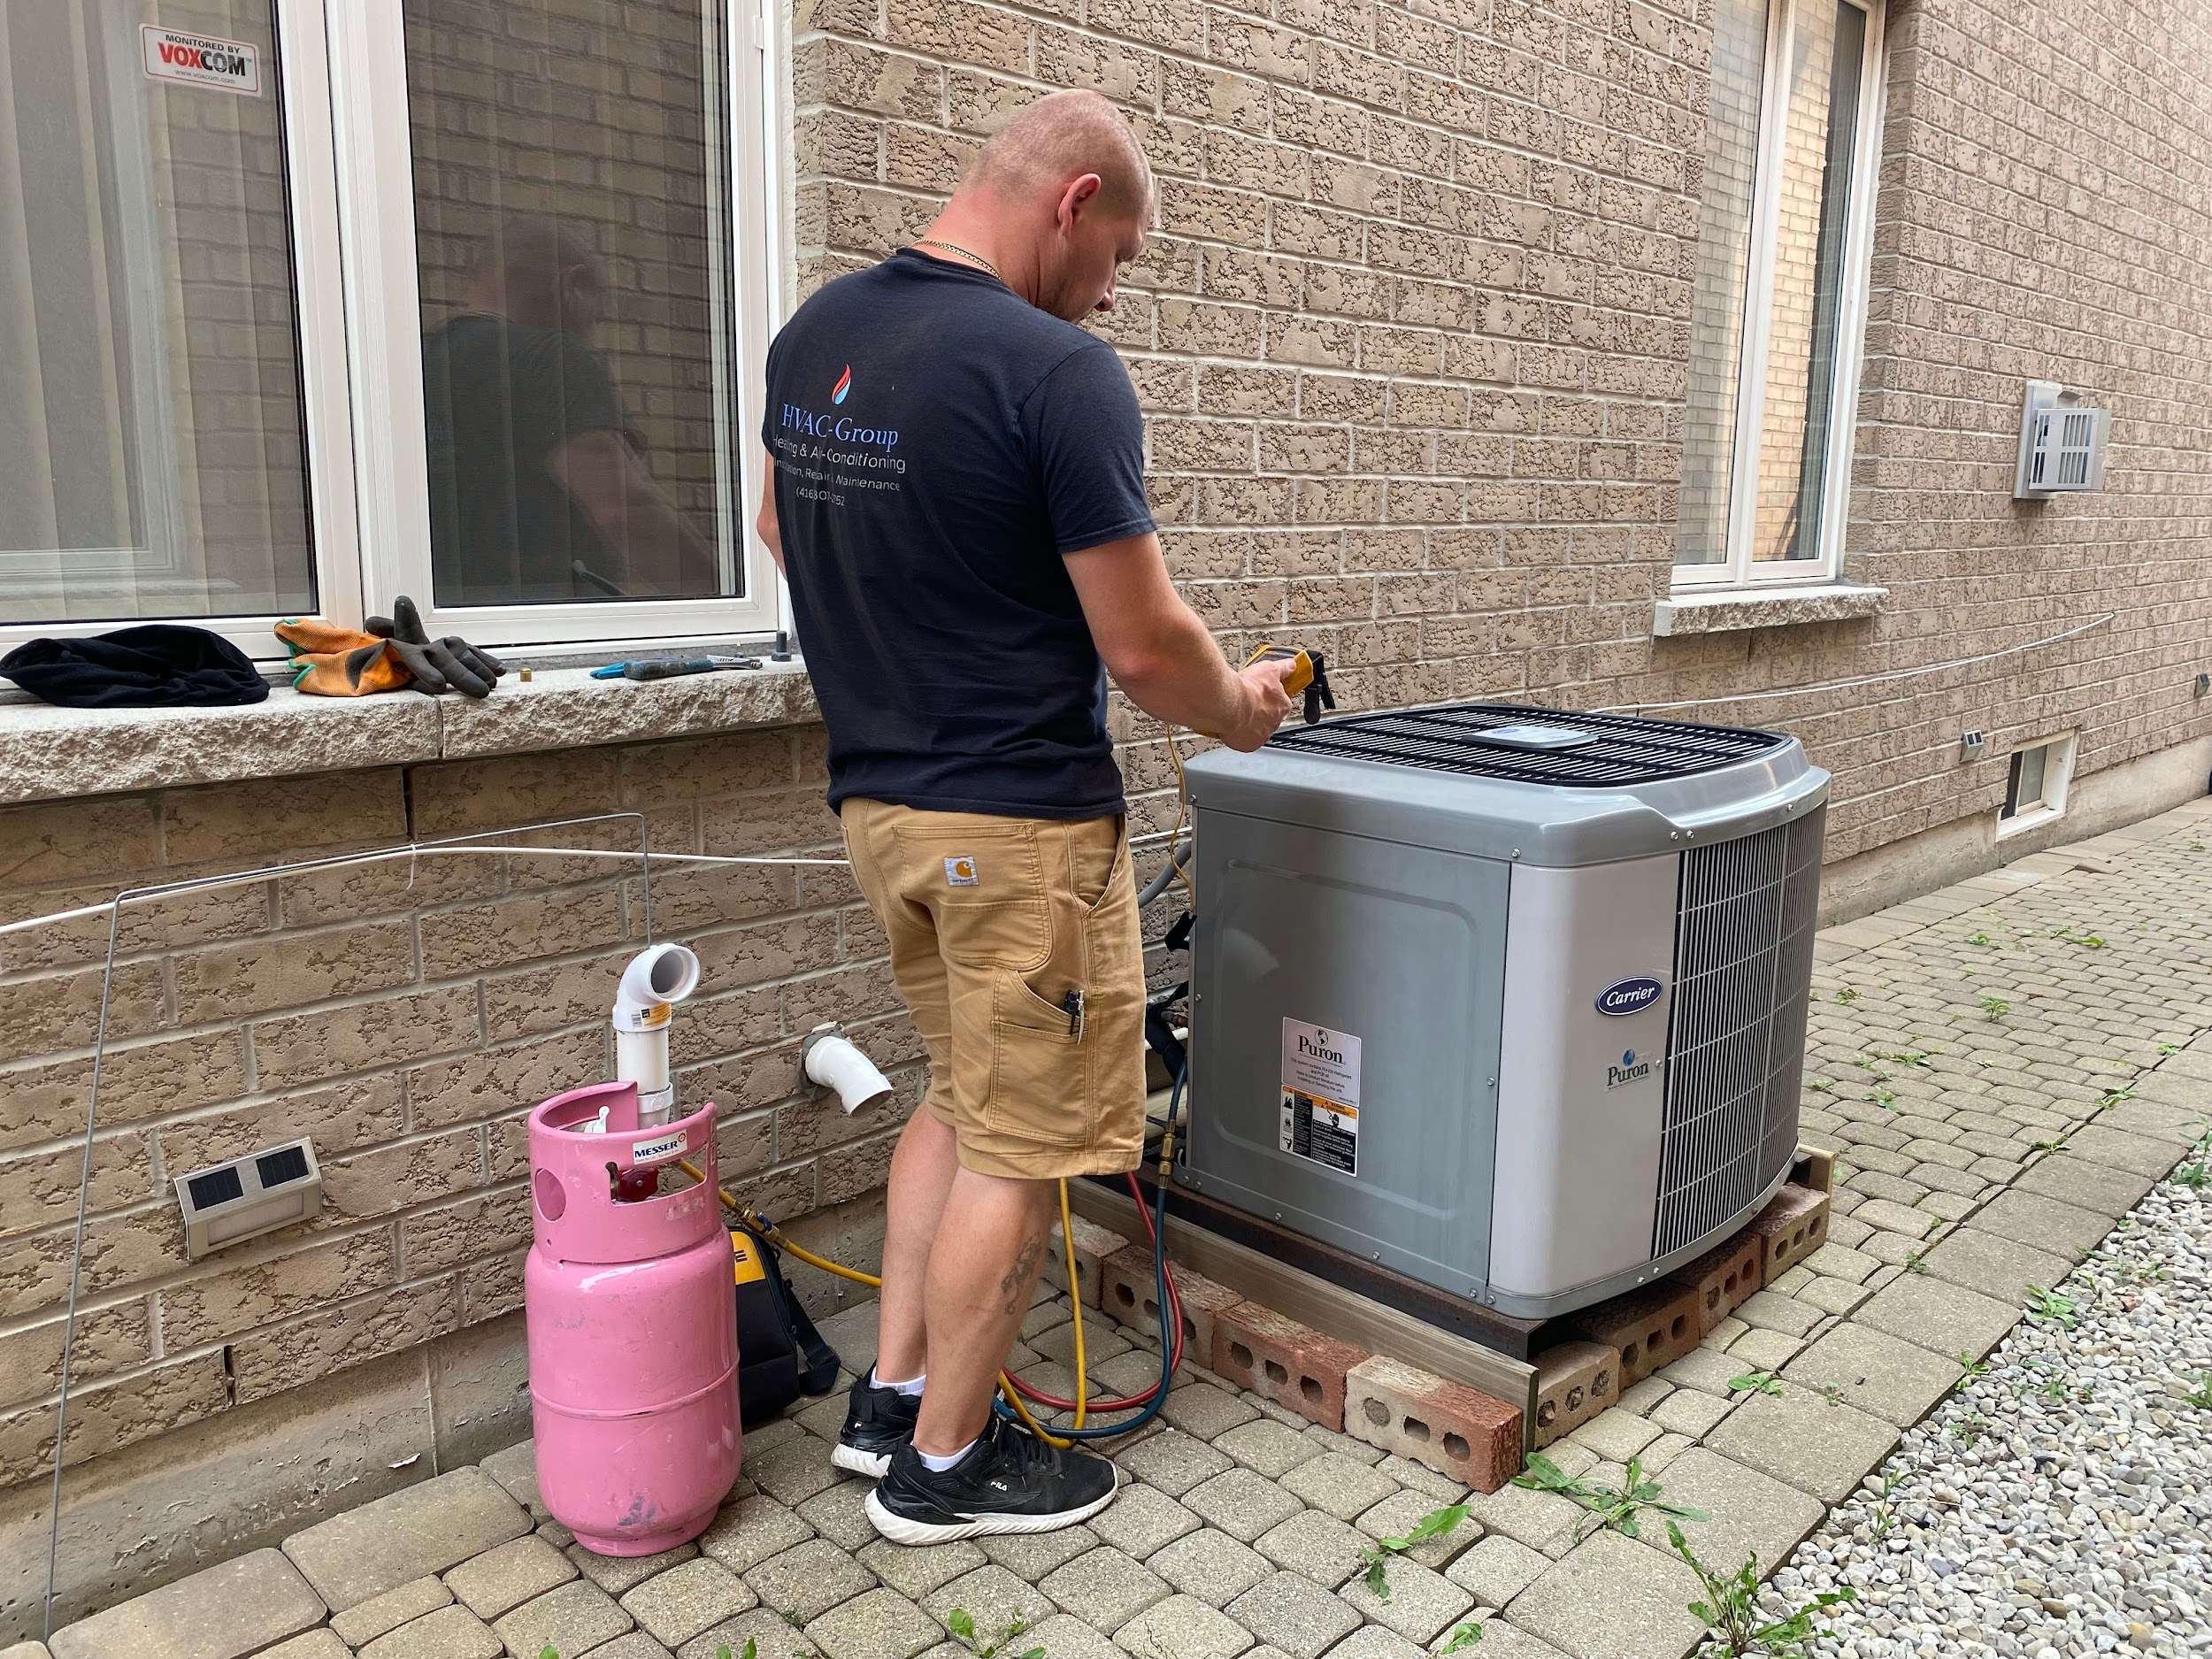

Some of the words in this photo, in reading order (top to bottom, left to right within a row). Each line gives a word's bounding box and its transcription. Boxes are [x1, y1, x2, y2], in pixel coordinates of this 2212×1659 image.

[165, 35, 225, 51] MONITORED
[227, 45, 241, 54] BY
[157, 42, 246, 76] VOXCOM
[174, 69, 236, 85] www.voxcom.com
[781, 403, 899, 453] HVAC-Group
[799, 442, 808, 457] &
[805, 467, 833, 483] Reair,
[1606, 986, 1655, 1007] Carrier
[1298, 1034, 1343, 1064] Puron
[1607, 1062, 1649, 1087] Puron
[634, 1141, 678, 1158] MESSER
